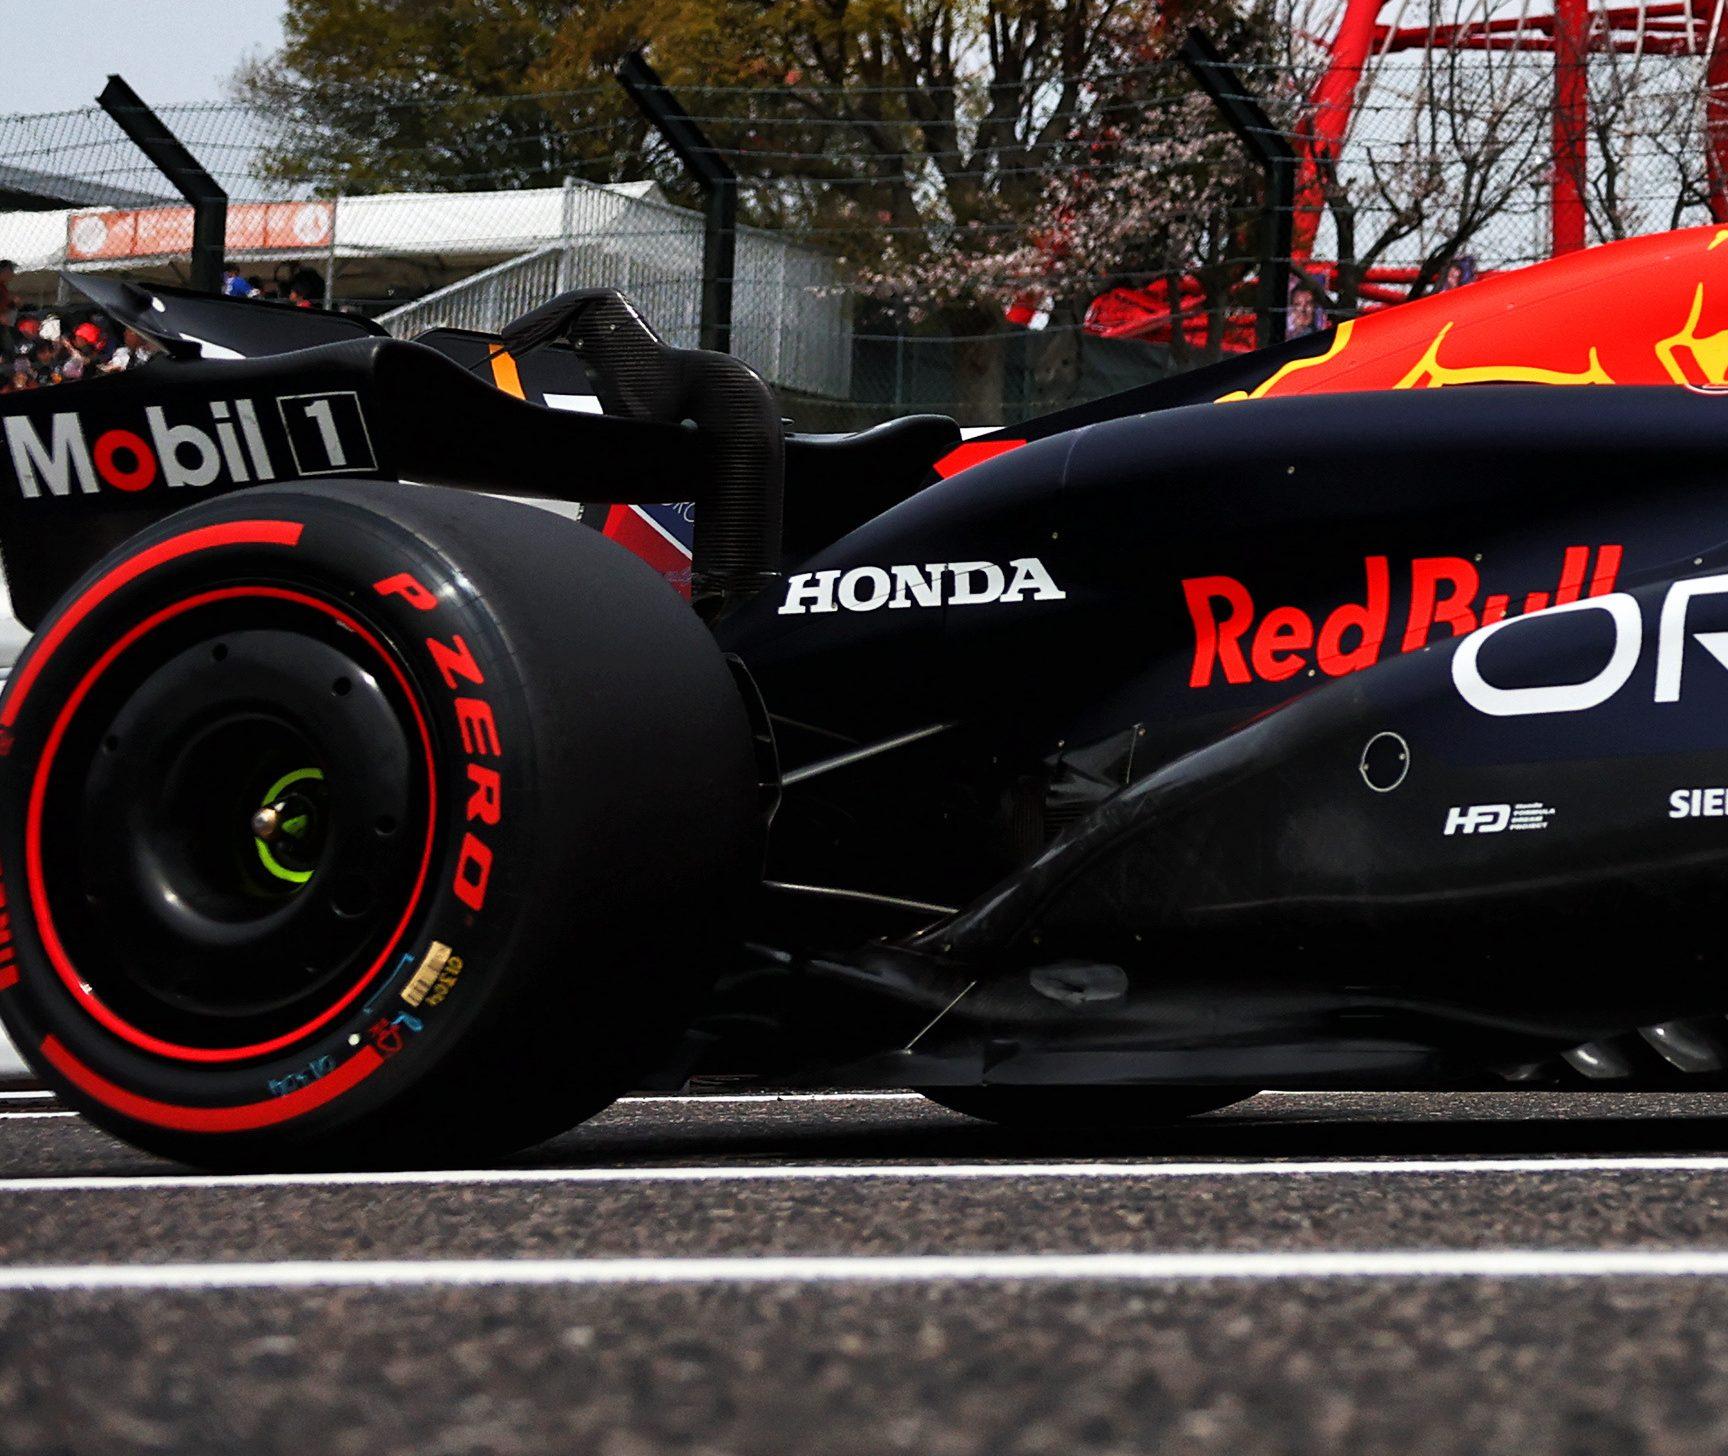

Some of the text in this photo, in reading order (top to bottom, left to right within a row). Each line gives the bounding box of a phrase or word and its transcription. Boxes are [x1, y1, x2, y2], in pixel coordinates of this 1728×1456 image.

[4, 398, 346, 498] Mobil 1
[777, 557, 1067, 615] HONDA
[1181, 555, 1390, 688] Red
[372, 572, 438, 612] P
[426, 635, 502, 912] ZERO
